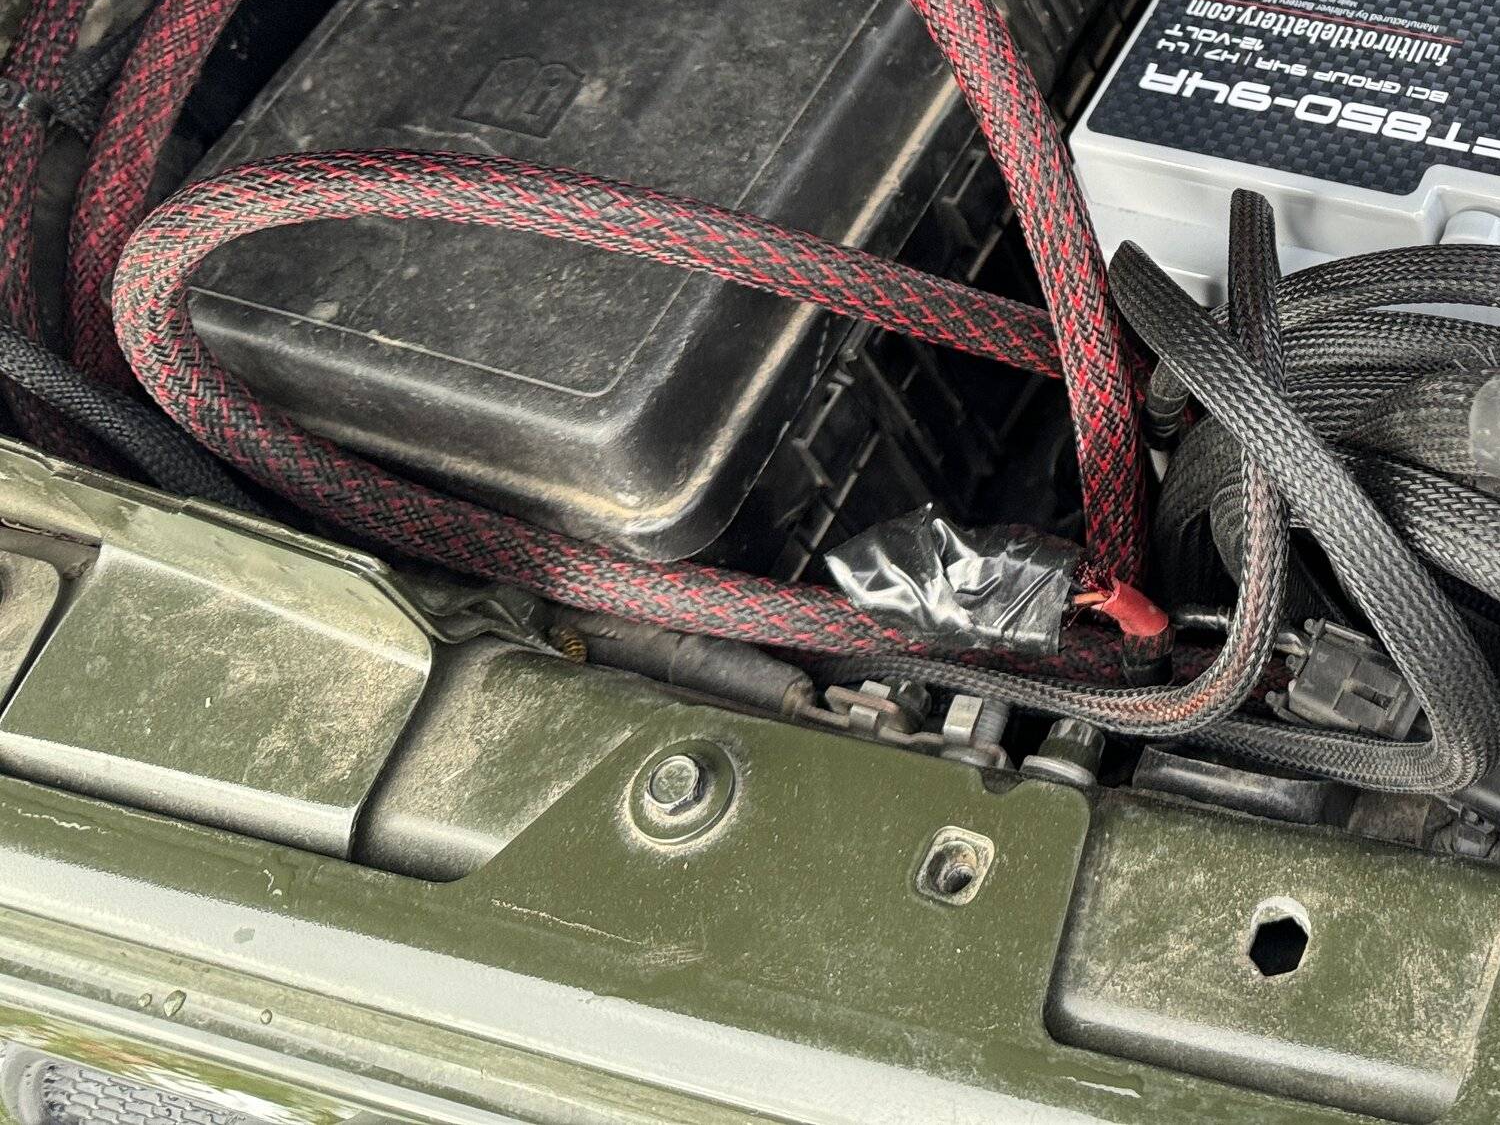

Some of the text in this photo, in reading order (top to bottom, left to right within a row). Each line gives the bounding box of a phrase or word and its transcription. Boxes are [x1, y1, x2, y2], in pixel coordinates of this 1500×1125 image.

[1314, 3, 1356, 19] Fullriver
[1355, 8, 1369, 22] by
[1368, 13, 1440, 33] Manufactured
[1156, 38, 1190, 54] L4
[1164, 23, 1265, 52] 12-VOLT
[1203, 48, 1241, 64] H7
[1254, 56, 1308, 77] 94R
[1312, 69, 1402, 95] GROUP
[1405, 85, 1449, 104] BCI
